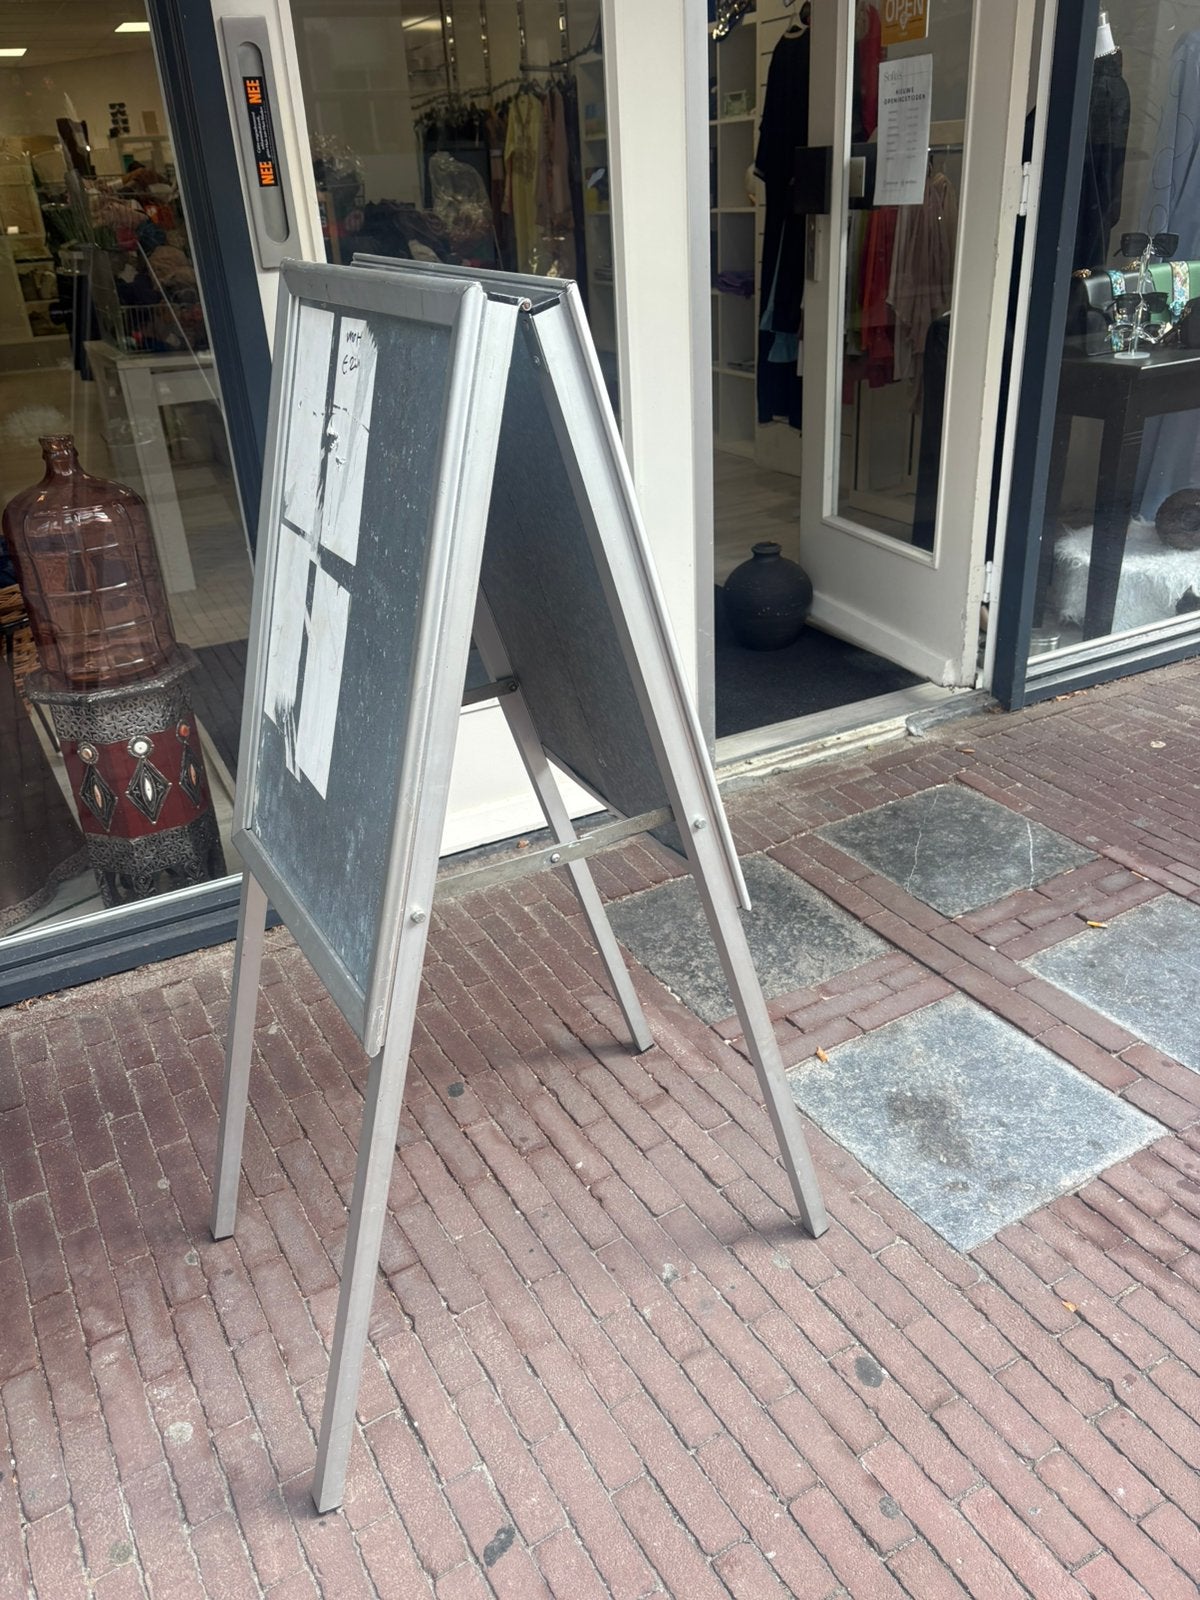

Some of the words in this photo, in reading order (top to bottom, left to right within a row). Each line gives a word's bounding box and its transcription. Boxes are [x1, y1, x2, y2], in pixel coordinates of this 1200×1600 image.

[885, 0, 924, 22] OPEN
[246, 79, 262, 104] NEE
[259, 161, 275, 185] NEE
